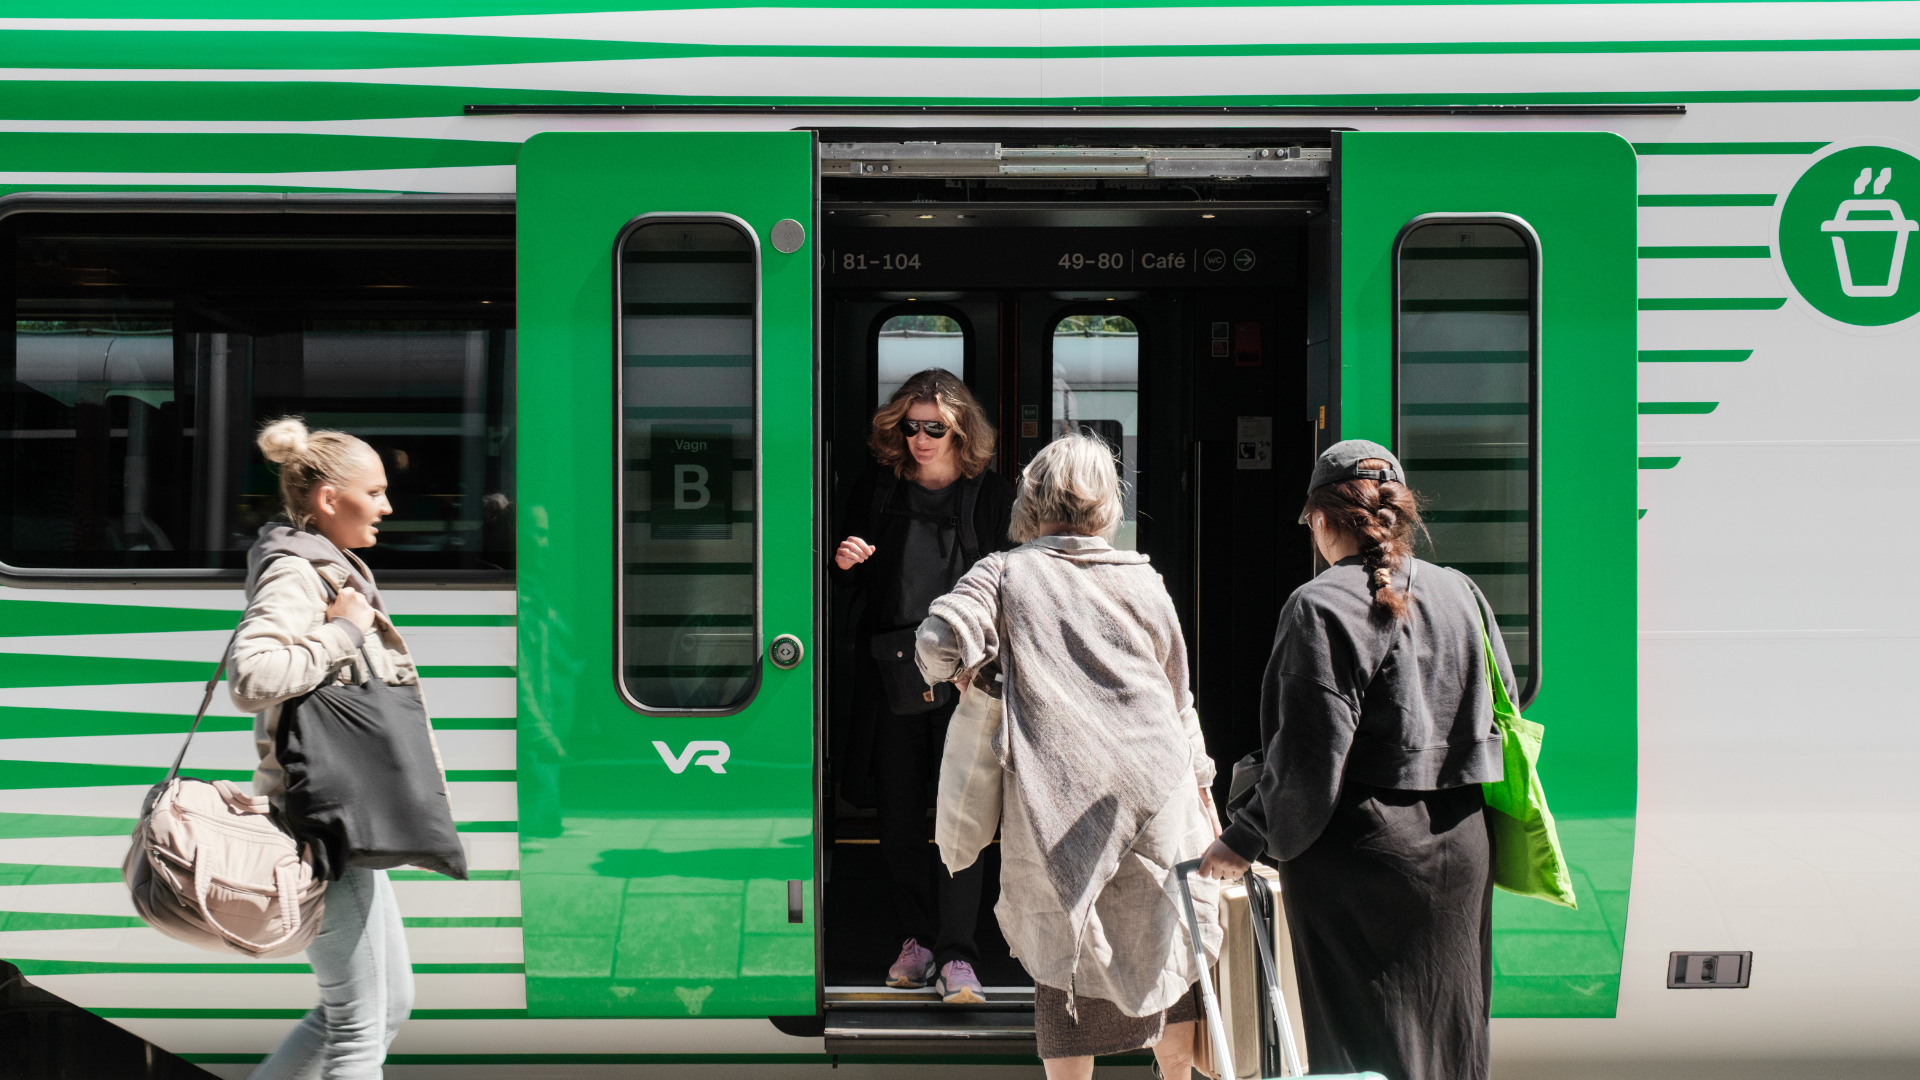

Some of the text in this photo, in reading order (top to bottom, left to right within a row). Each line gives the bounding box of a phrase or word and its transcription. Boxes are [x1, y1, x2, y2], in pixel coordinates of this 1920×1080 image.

[843, 253, 922, 270] 81–104
[1058, 252, 1222, 270] 49–80 Café WC
[674, 439, 707, 453] Vagn
[674, 464, 711, 510] B
[651, 740, 731, 774] VR
